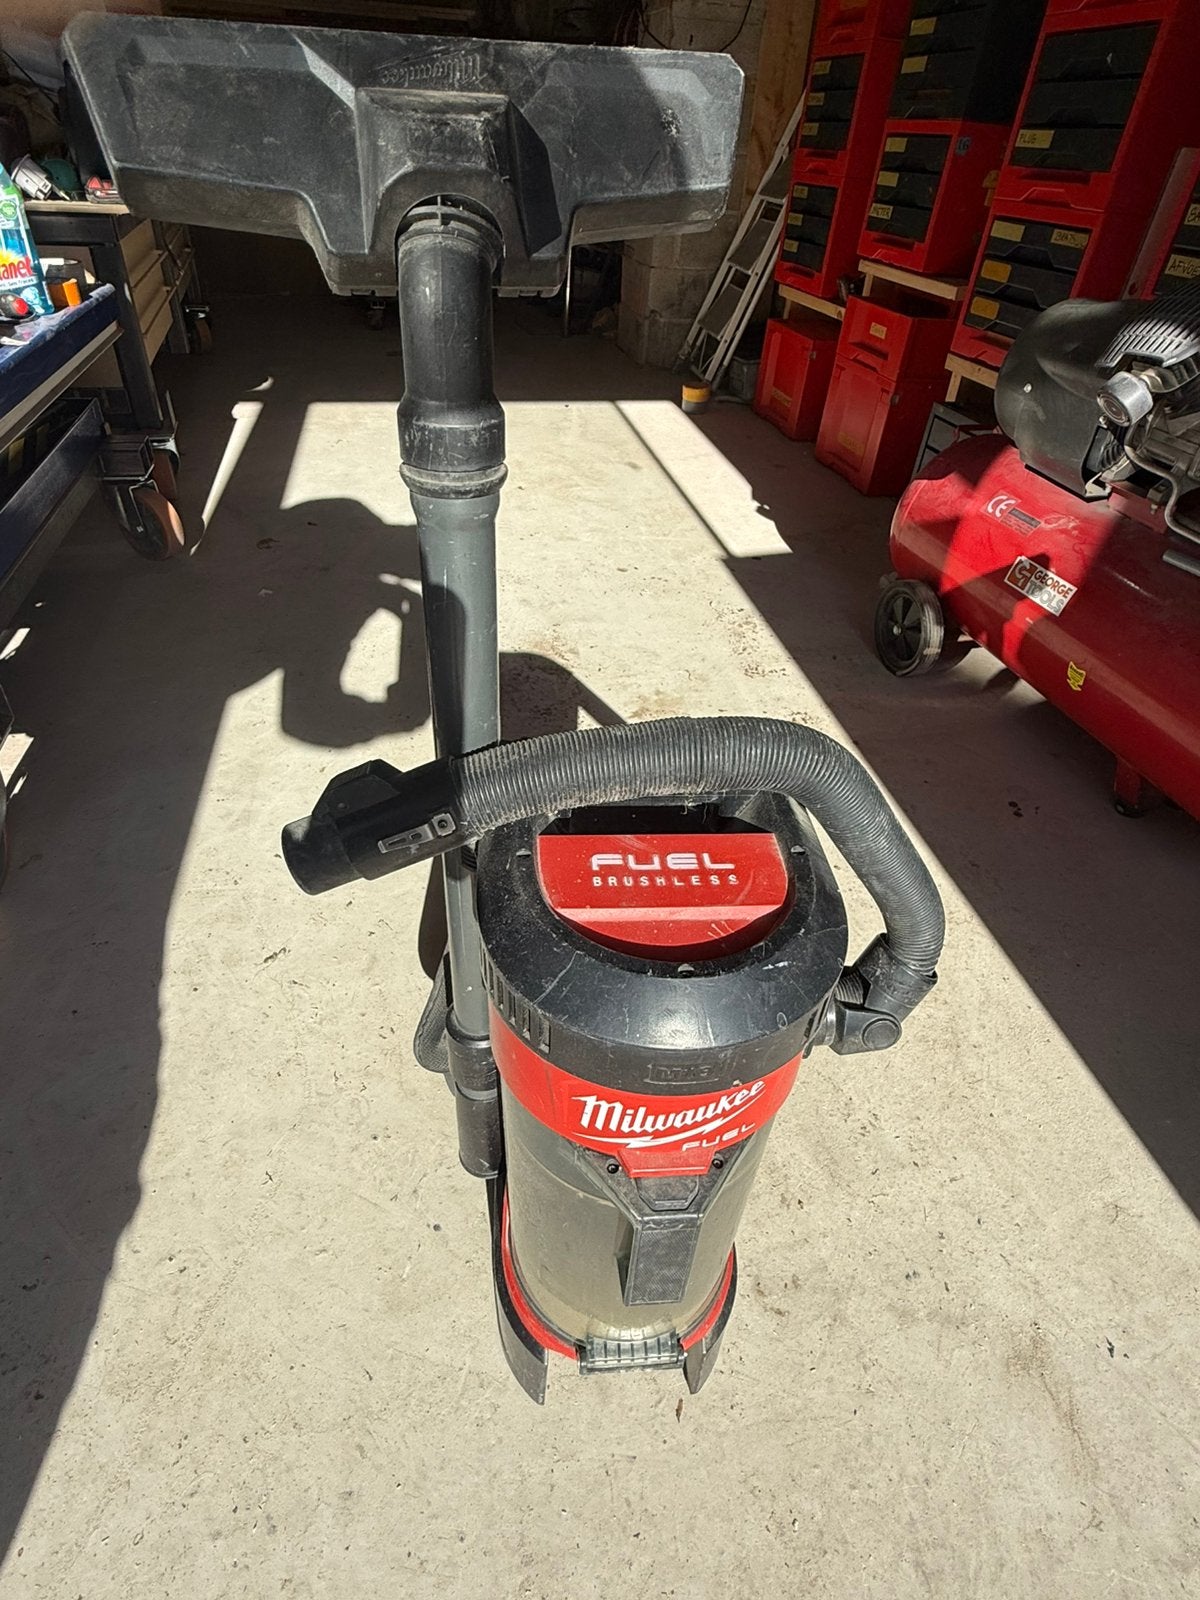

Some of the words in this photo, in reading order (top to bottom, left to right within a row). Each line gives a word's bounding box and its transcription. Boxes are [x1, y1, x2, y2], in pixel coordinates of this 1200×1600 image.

[380, 51, 488, 89] Milwaukee
[987, 495, 1017, 518] CE
[1026, 580, 1065, 613] TOOLS
[1034, 570, 1073, 599] GEORGE
[590, 853, 736, 871] FUEL
[592, 874, 739, 887] BRUSHLESS
[571, 1080, 766, 1133] Milwaukee
[681, 1122, 756, 1152] FUEL
